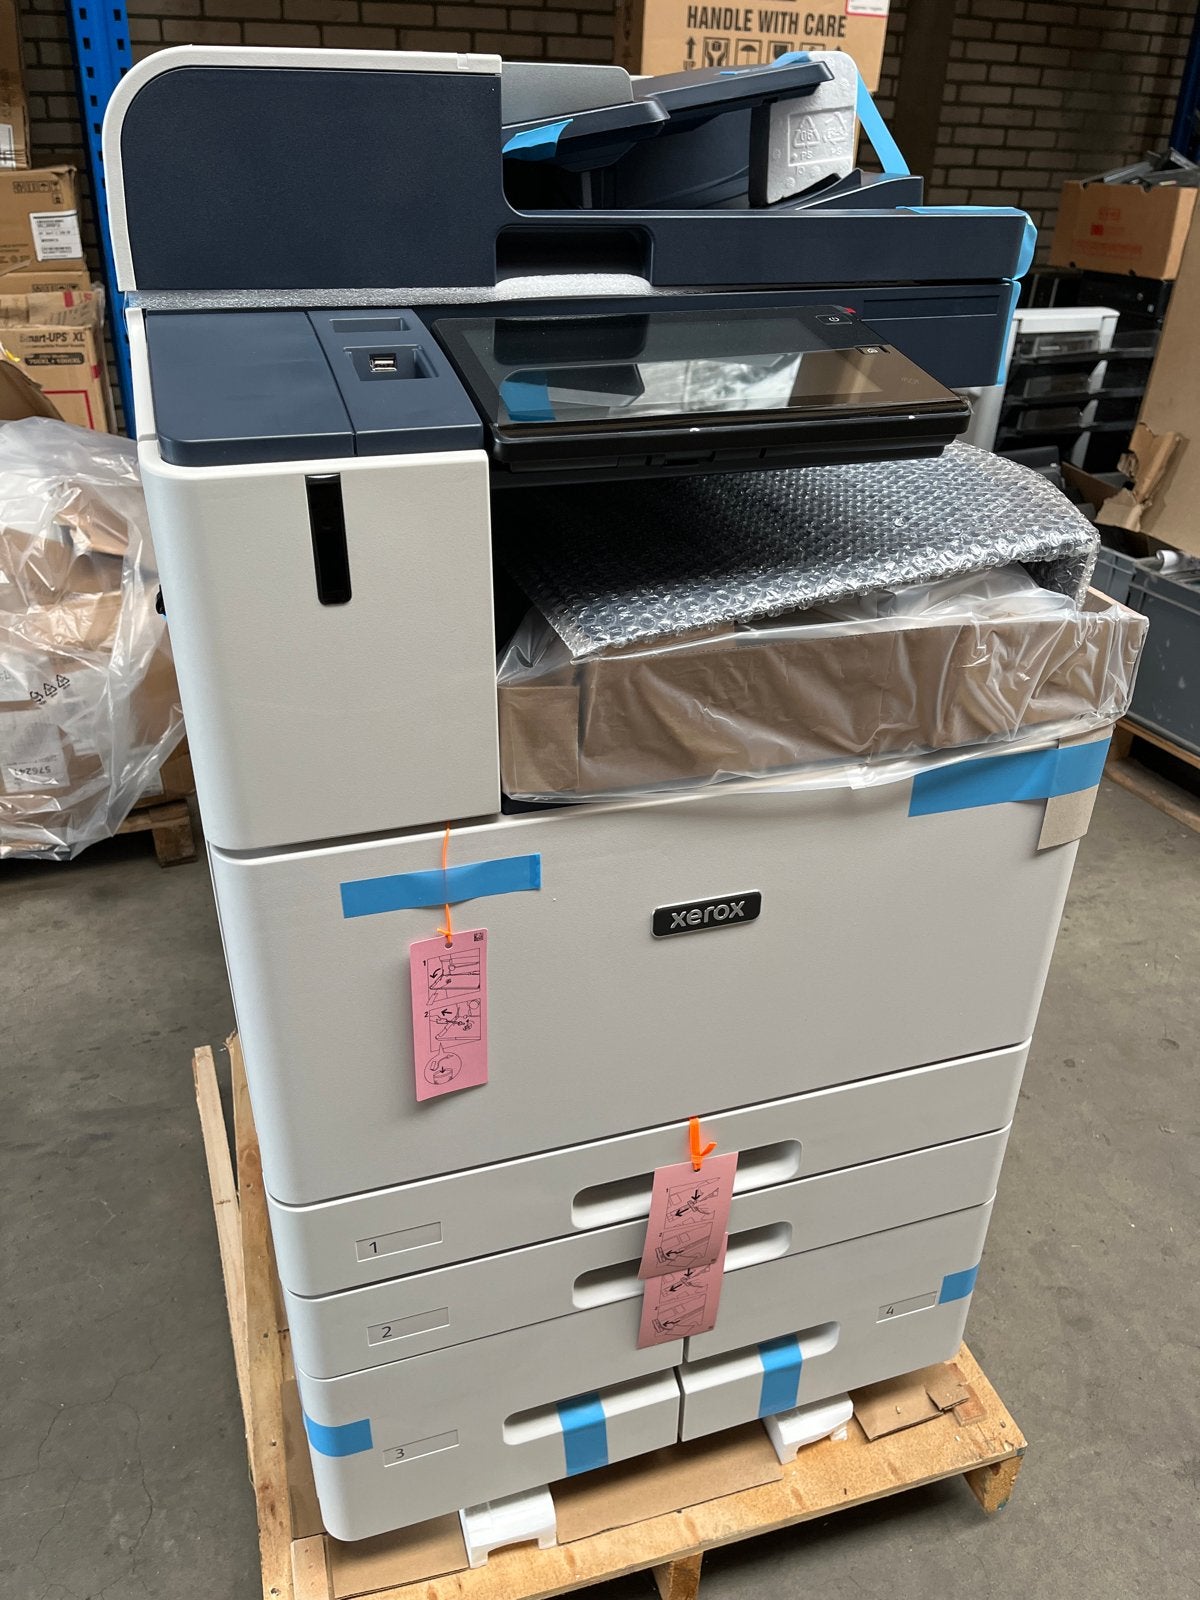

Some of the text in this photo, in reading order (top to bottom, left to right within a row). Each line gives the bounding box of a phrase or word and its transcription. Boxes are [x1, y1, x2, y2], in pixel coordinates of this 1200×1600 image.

[687, 5, 847, 38] HANDLE WITH CARE
[72, 332, 85, 342] XL
[670, 900, 746, 929] xerox
[369, 1241, 378, 1254] 1
[886, 1306, 894, 1315] 4
[382, 1326, 393, 1339] 2
[395, 1448, 405, 1459] 3
